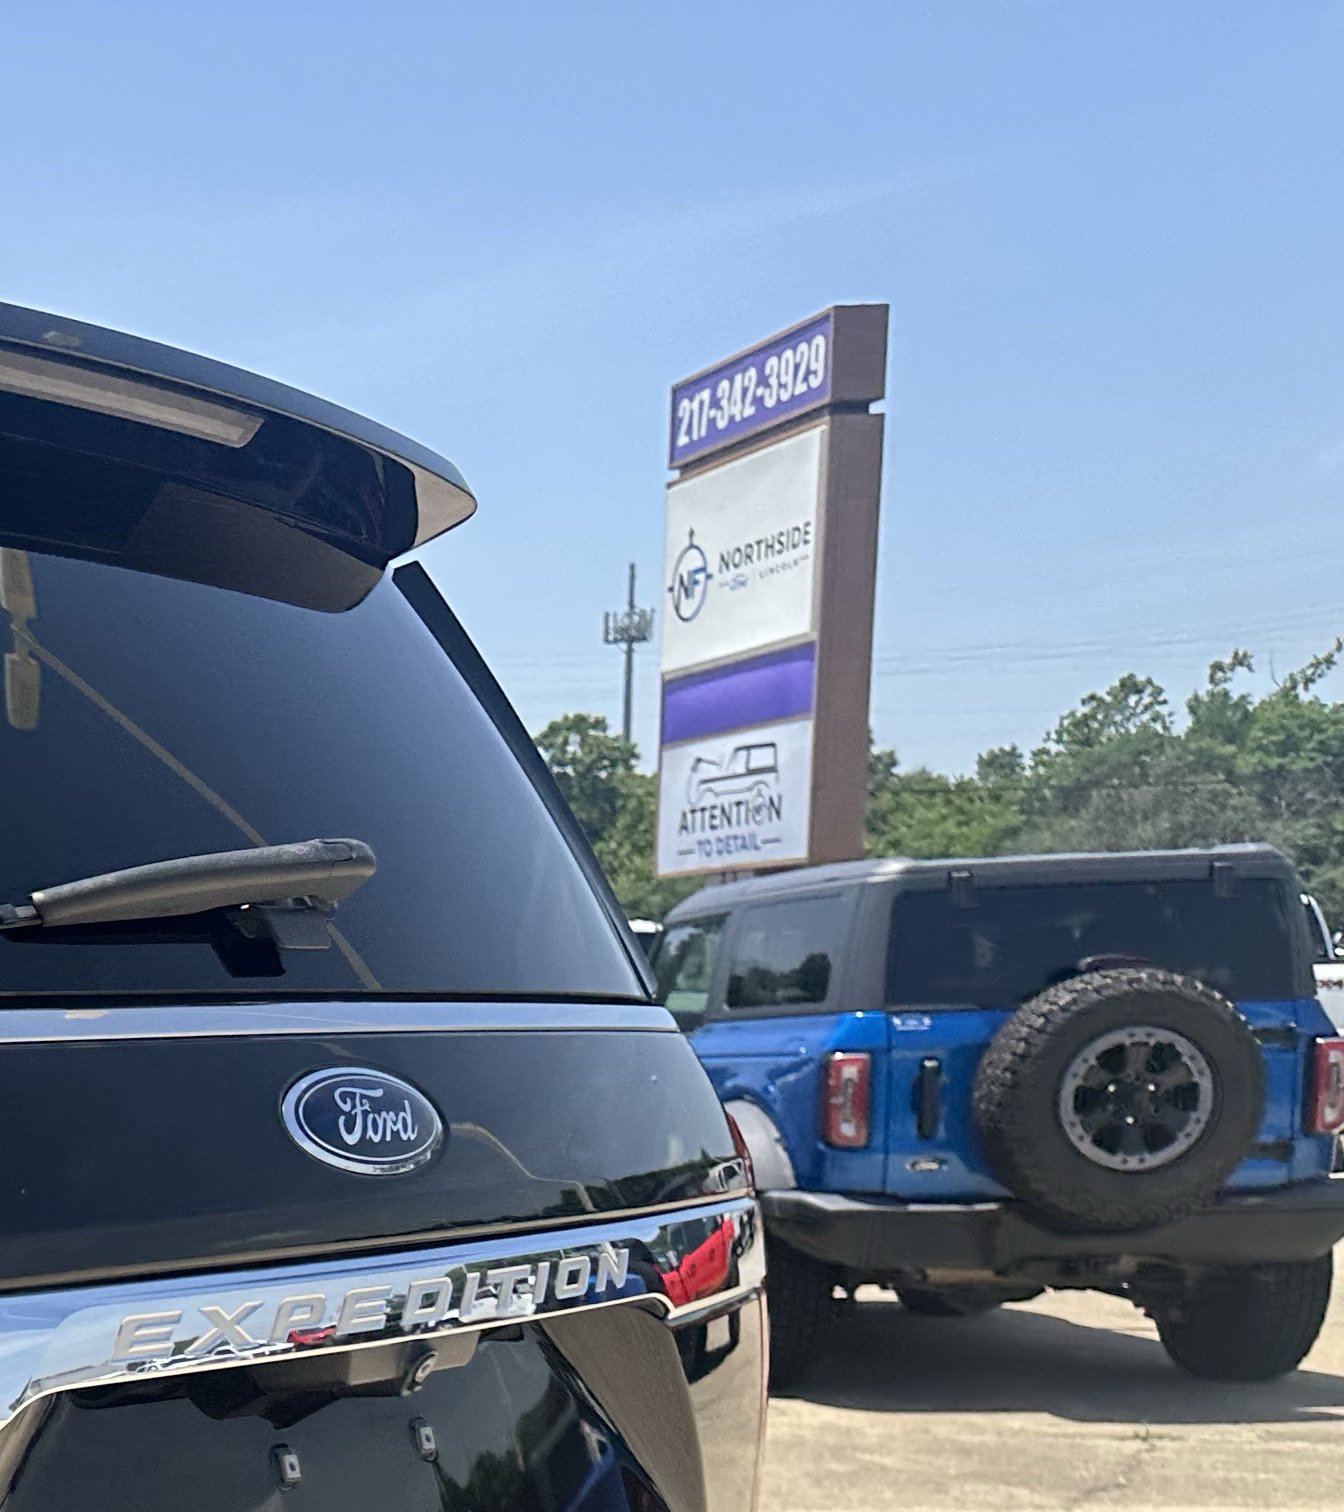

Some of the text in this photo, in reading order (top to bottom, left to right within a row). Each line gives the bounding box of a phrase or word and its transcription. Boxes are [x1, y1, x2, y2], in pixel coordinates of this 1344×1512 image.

[676, 334, 826, 447] 217-342-3929
[717, 520, 812, 575] NORTHSIDE
[677, 792, 783, 836] ATTENTION
[696, 832, 761, 858] TO DETAIL
[333, 1086, 419, 1146] Ford
[114, 1241, 631, 1360] EXPEDITION
